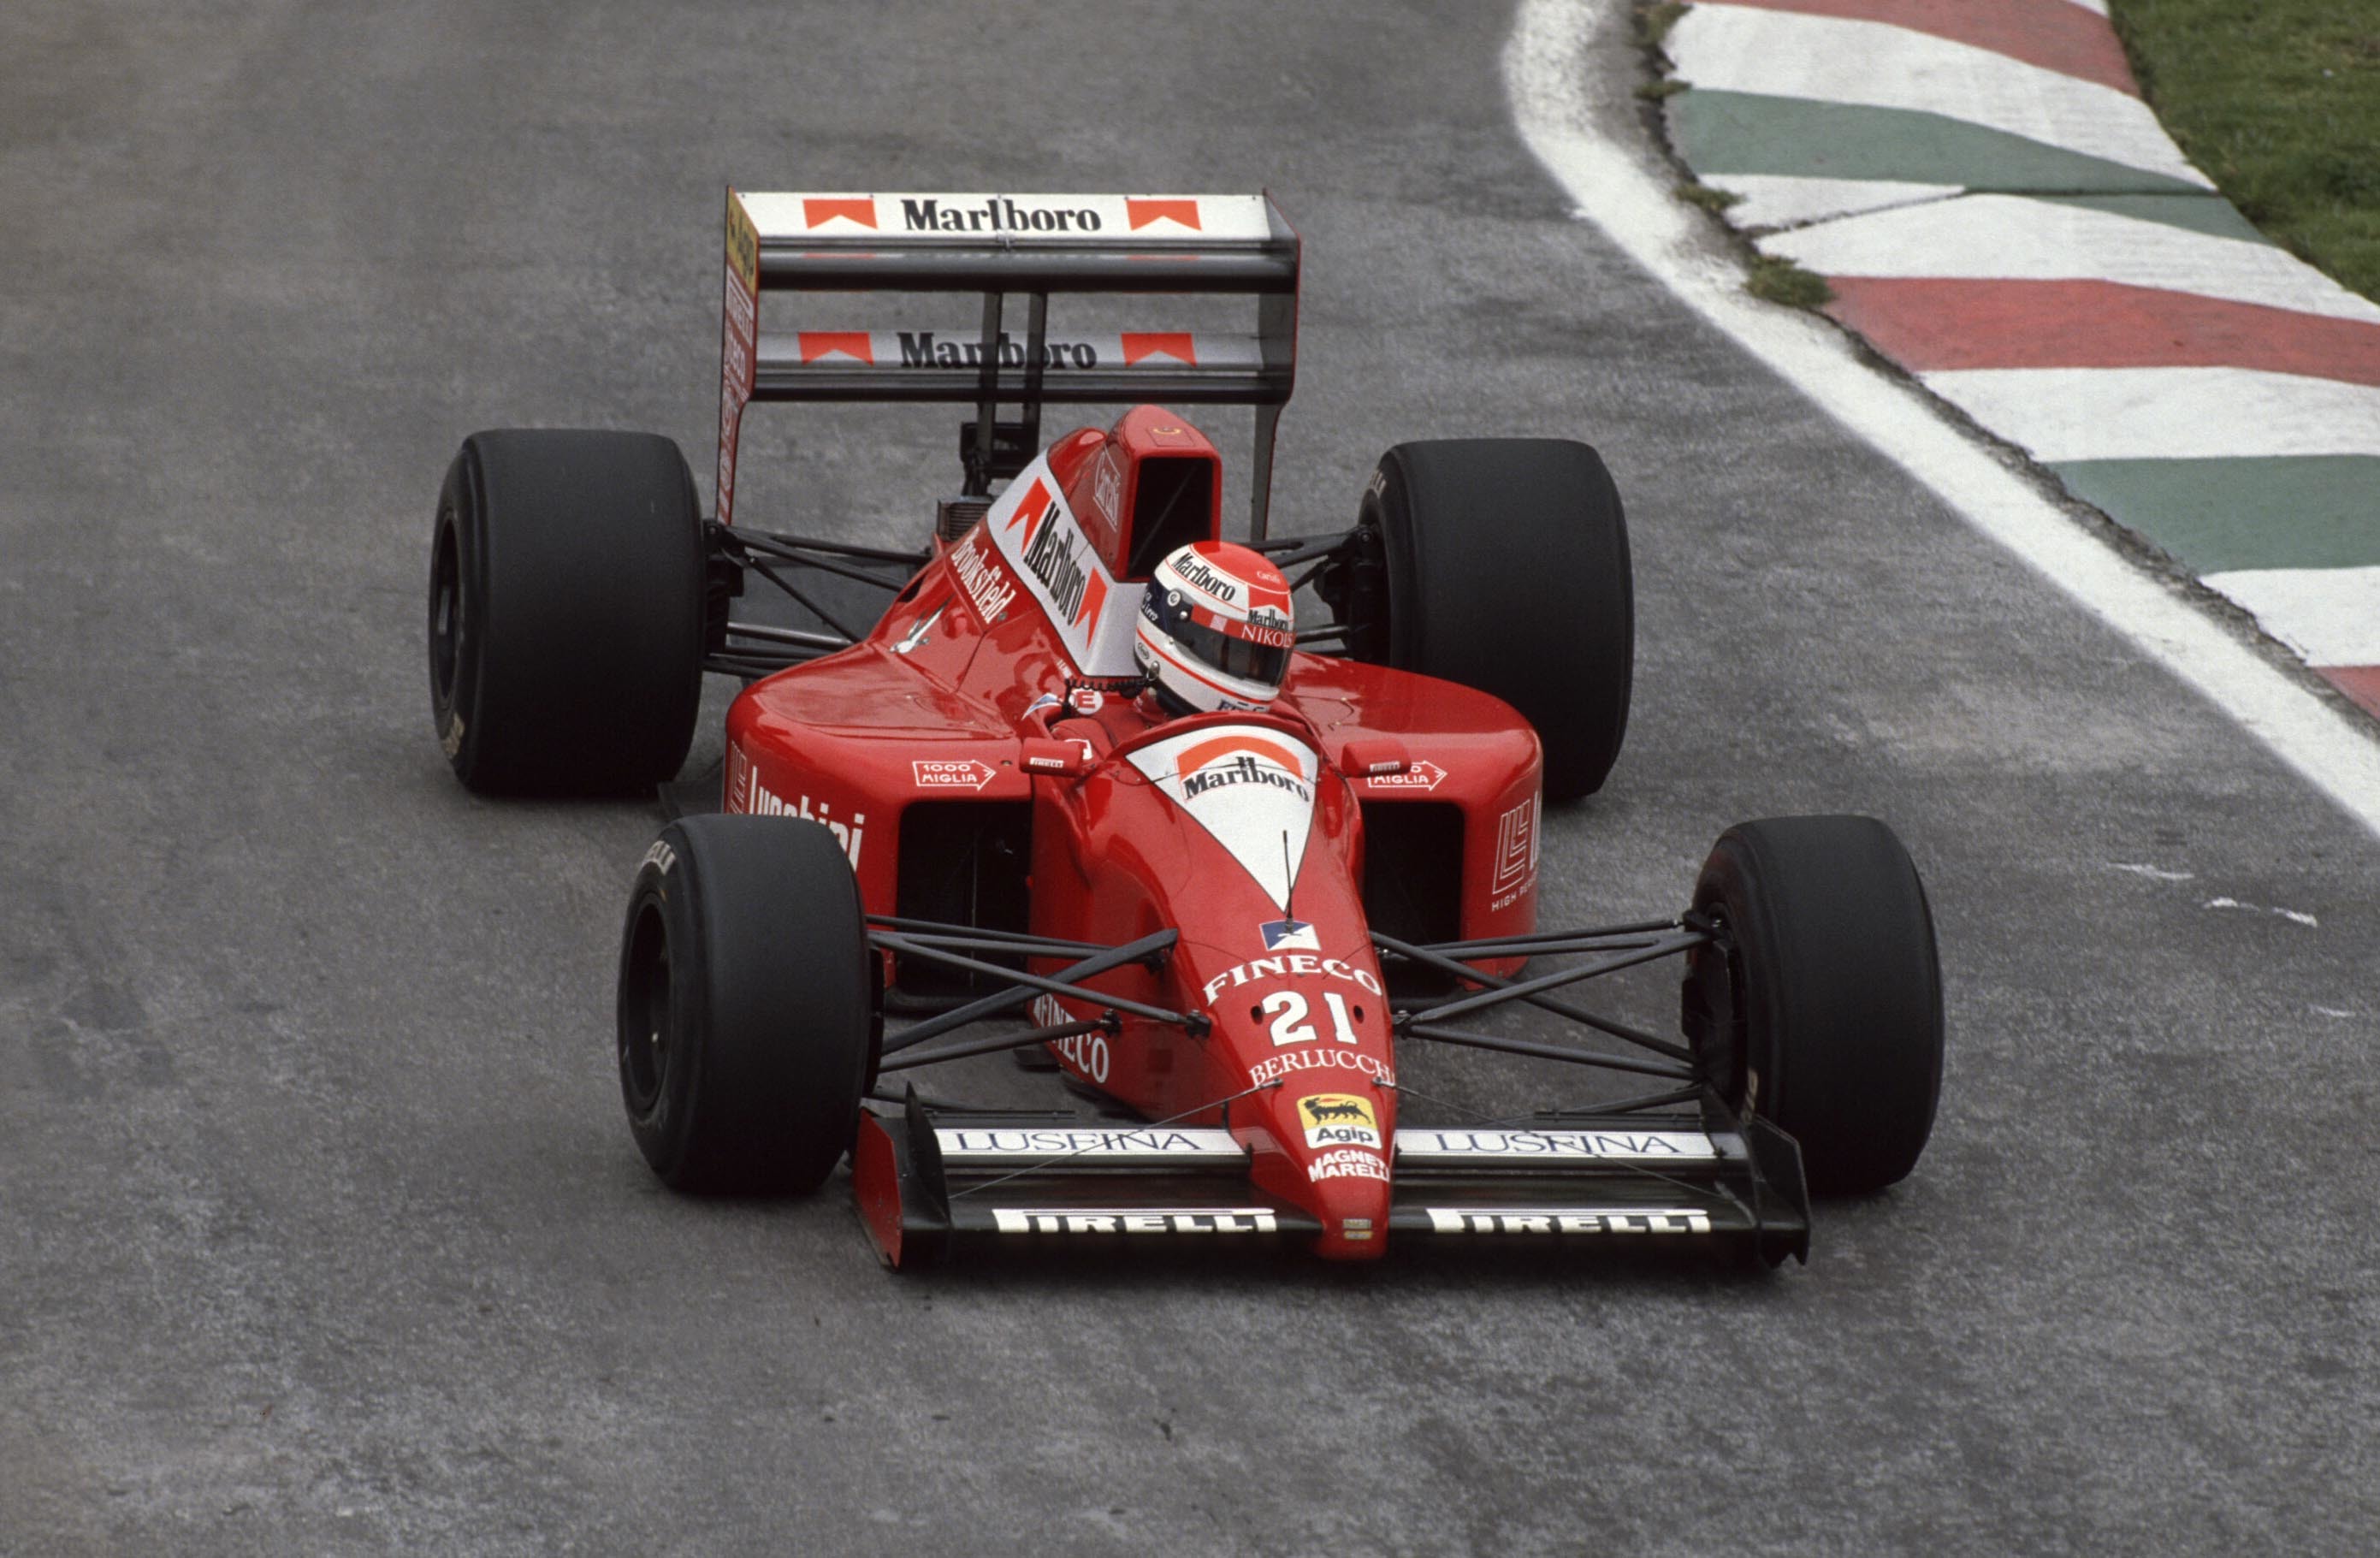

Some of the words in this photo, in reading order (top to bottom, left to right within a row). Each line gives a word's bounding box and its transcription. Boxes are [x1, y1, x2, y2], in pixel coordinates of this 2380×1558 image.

[901, 198, 1102, 231] Marlboro
[897, 332, 1097, 369] Marbro
[1023, 501, 1086, 626] Marlboro
[1171, 552, 1235, 601] Marlboro
[922, 773, 977, 783] MIGLIA
[1183, 756, 1310, 803] Marlboro
[1374, 775, 1430, 784] MIGLIA
[1203, 955, 1382, 1007] FINECO
[1262, 991, 1358, 1047] 21
[956, 1133, 1203, 1152] LUSFINA
[1317, 1127, 1374, 1143] Agip
[992, 1208, 1277, 1233] PIRELLI
[1426, 1207, 1712, 1233] PIRELLI
